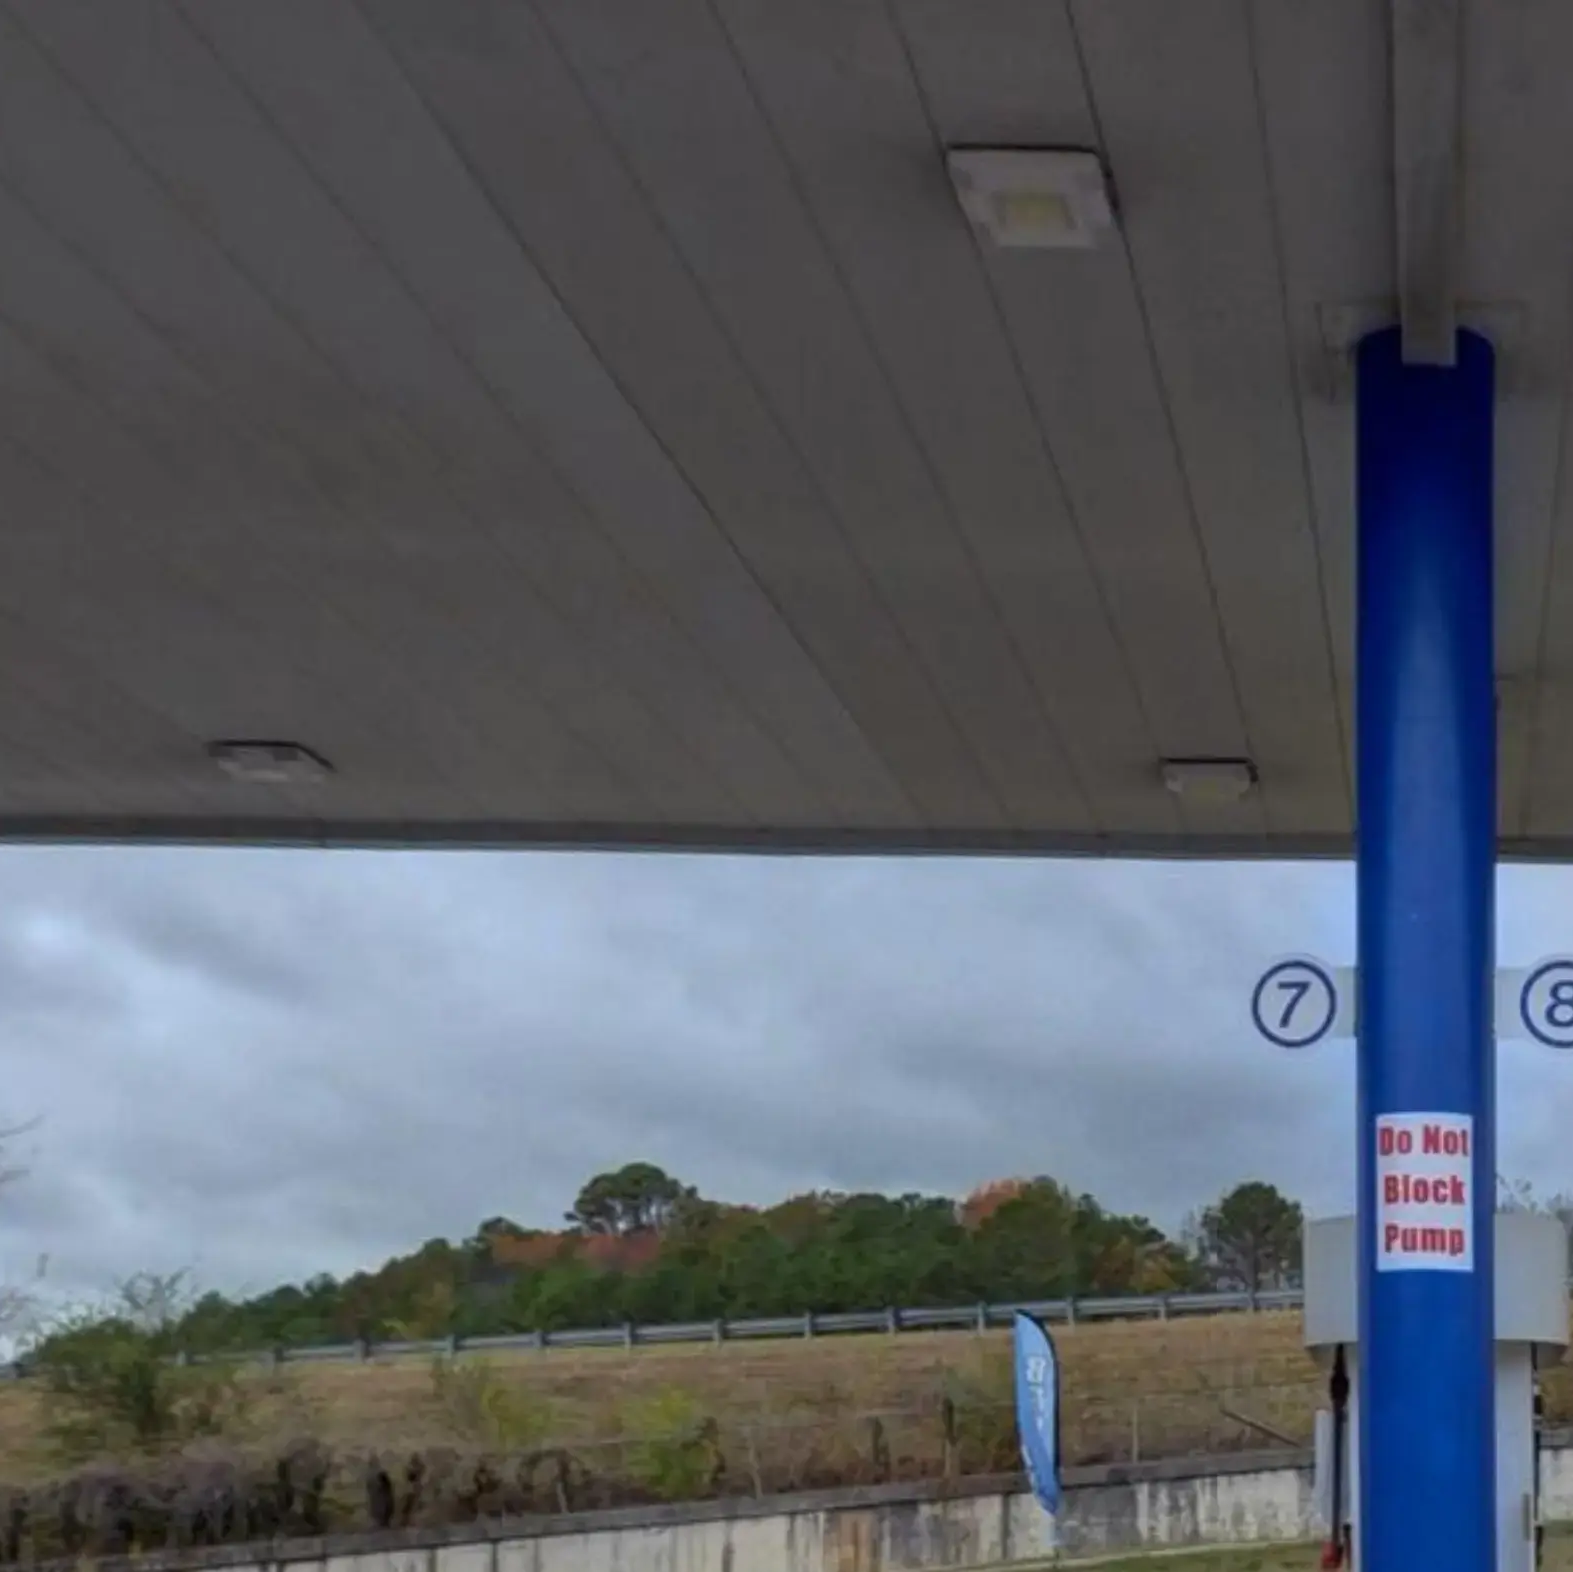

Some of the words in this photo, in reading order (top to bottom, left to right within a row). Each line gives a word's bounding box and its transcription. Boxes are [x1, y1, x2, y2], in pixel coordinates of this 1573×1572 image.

[1277, 980, 1312, 1029] 7
[1378, 1126, 1413, 1156] Do
[1422, 1124, 1469, 1157] Not
[1384, 1175, 1466, 1205] Block
[1384, 1223, 1465, 1257] Pump
